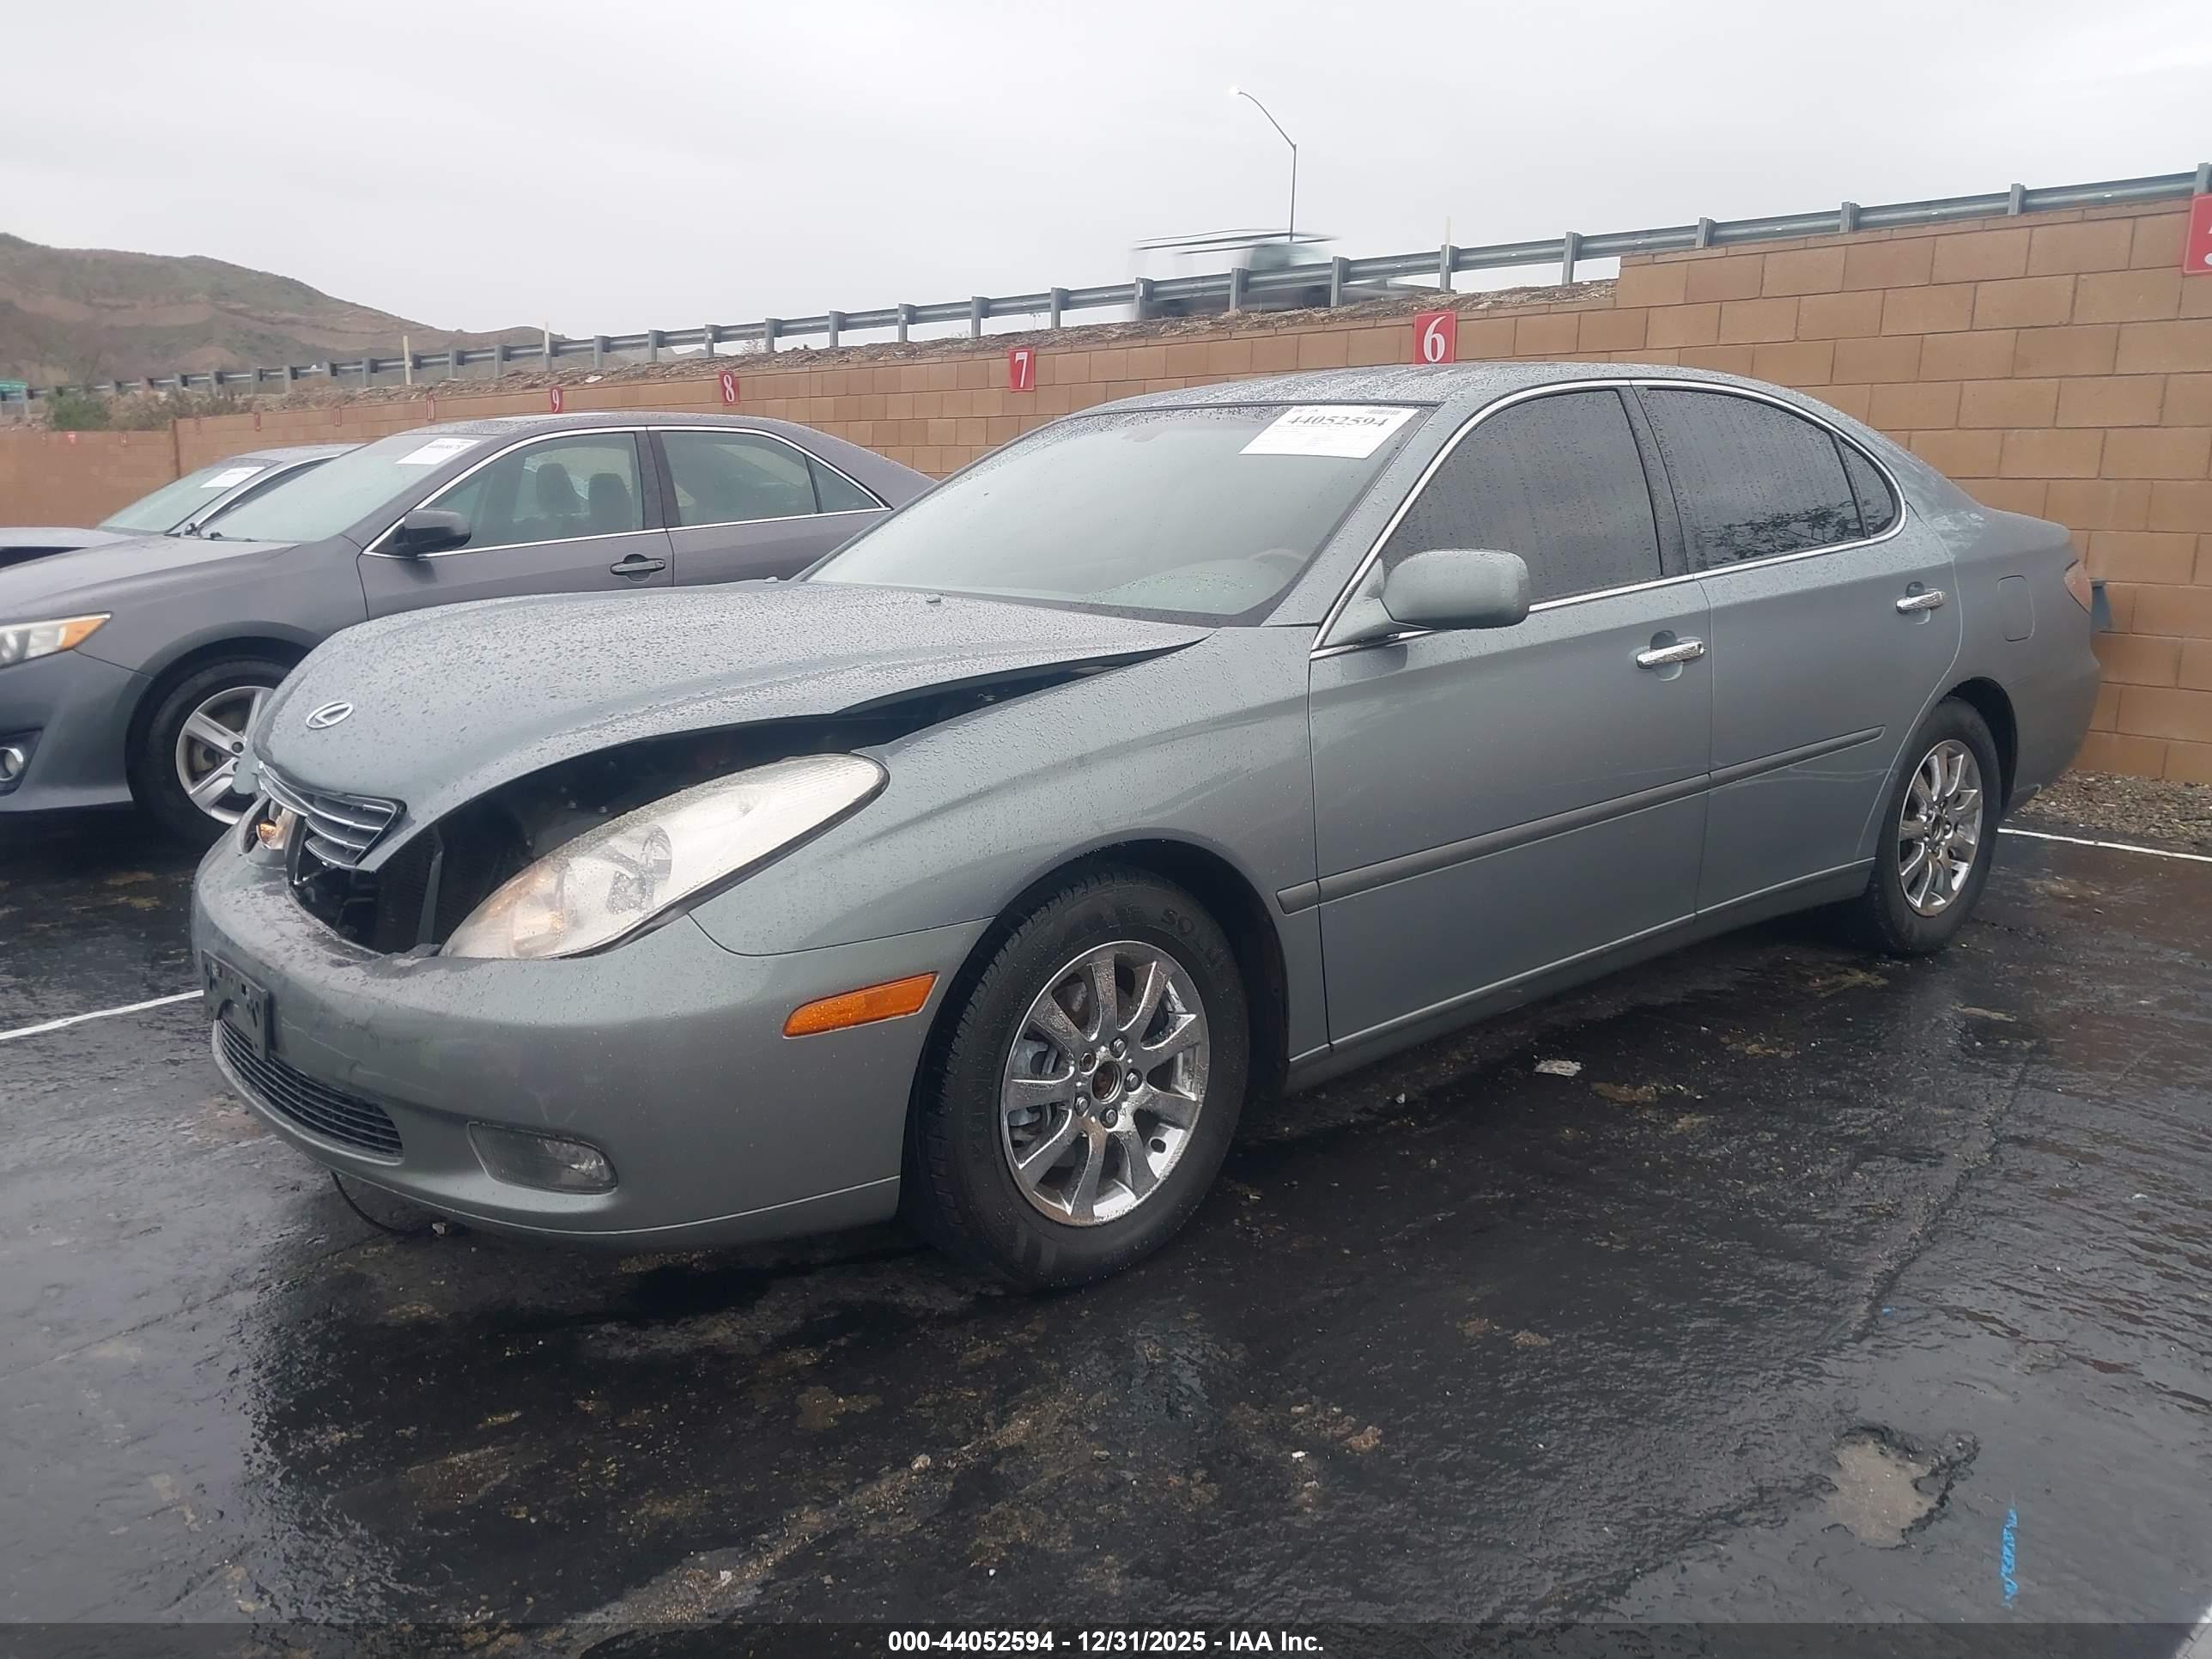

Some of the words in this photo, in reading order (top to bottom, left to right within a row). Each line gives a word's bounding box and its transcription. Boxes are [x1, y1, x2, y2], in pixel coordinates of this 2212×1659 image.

[1423, 315, 1447, 362] 6
[1015, 351, 1029, 388] 7
[552, 389, 560, 413] 9
[723, 374, 735, 403] 8
[1286, 416, 1389, 427] 44052594
